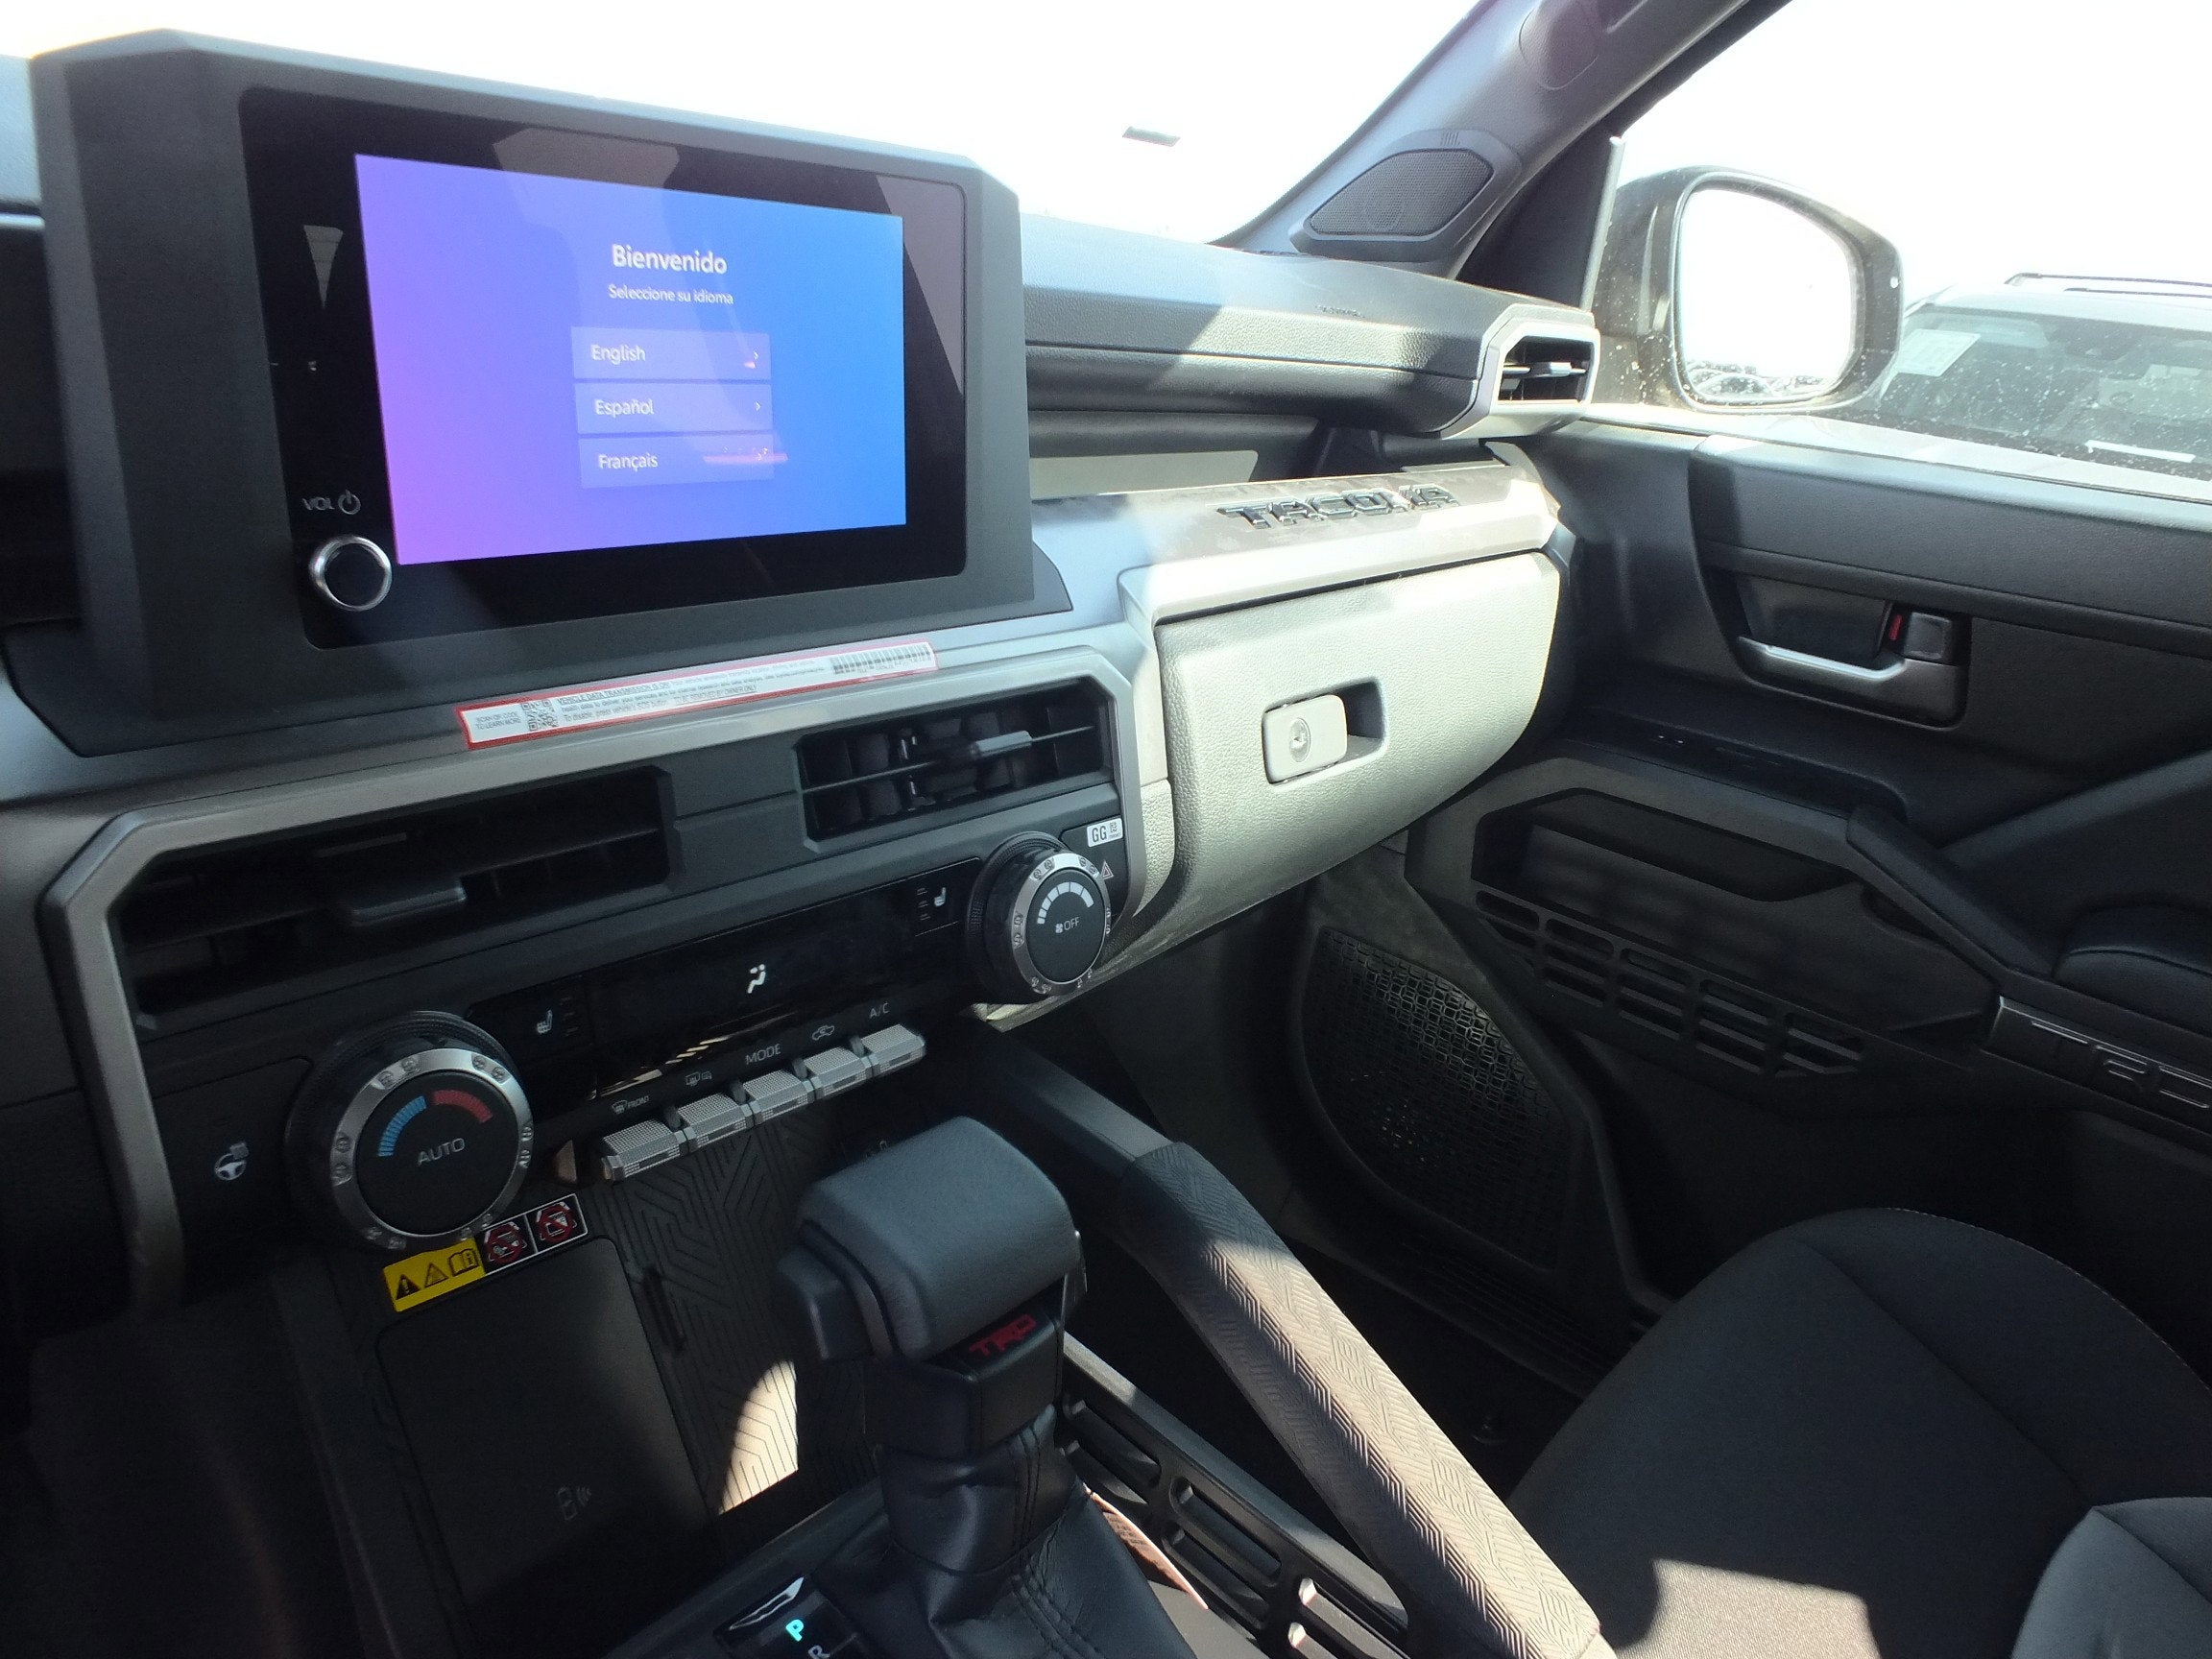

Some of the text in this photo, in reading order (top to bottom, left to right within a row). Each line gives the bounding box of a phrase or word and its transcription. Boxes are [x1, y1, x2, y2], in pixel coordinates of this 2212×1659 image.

[612, 243, 728, 275] Bienvenido
[608, 284, 733, 304] Seleccione su idioma
[590, 344, 646, 365] English
[595, 398, 655, 419] Español
[598, 452, 659, 471] Français
[302, 496, 334, 511] VOL
[1092, 826, 1107, 842] GG
[1064, 917, 1080, 930] OFF
[870, 1003, 889, 1018] A/C
[746, 1044, 781, 1065] MODE
[418, 1138, 465, 1166] AUTO
[970, 1313, 1037, 1356] TRD
[785, 1619, 805, 1642] P
